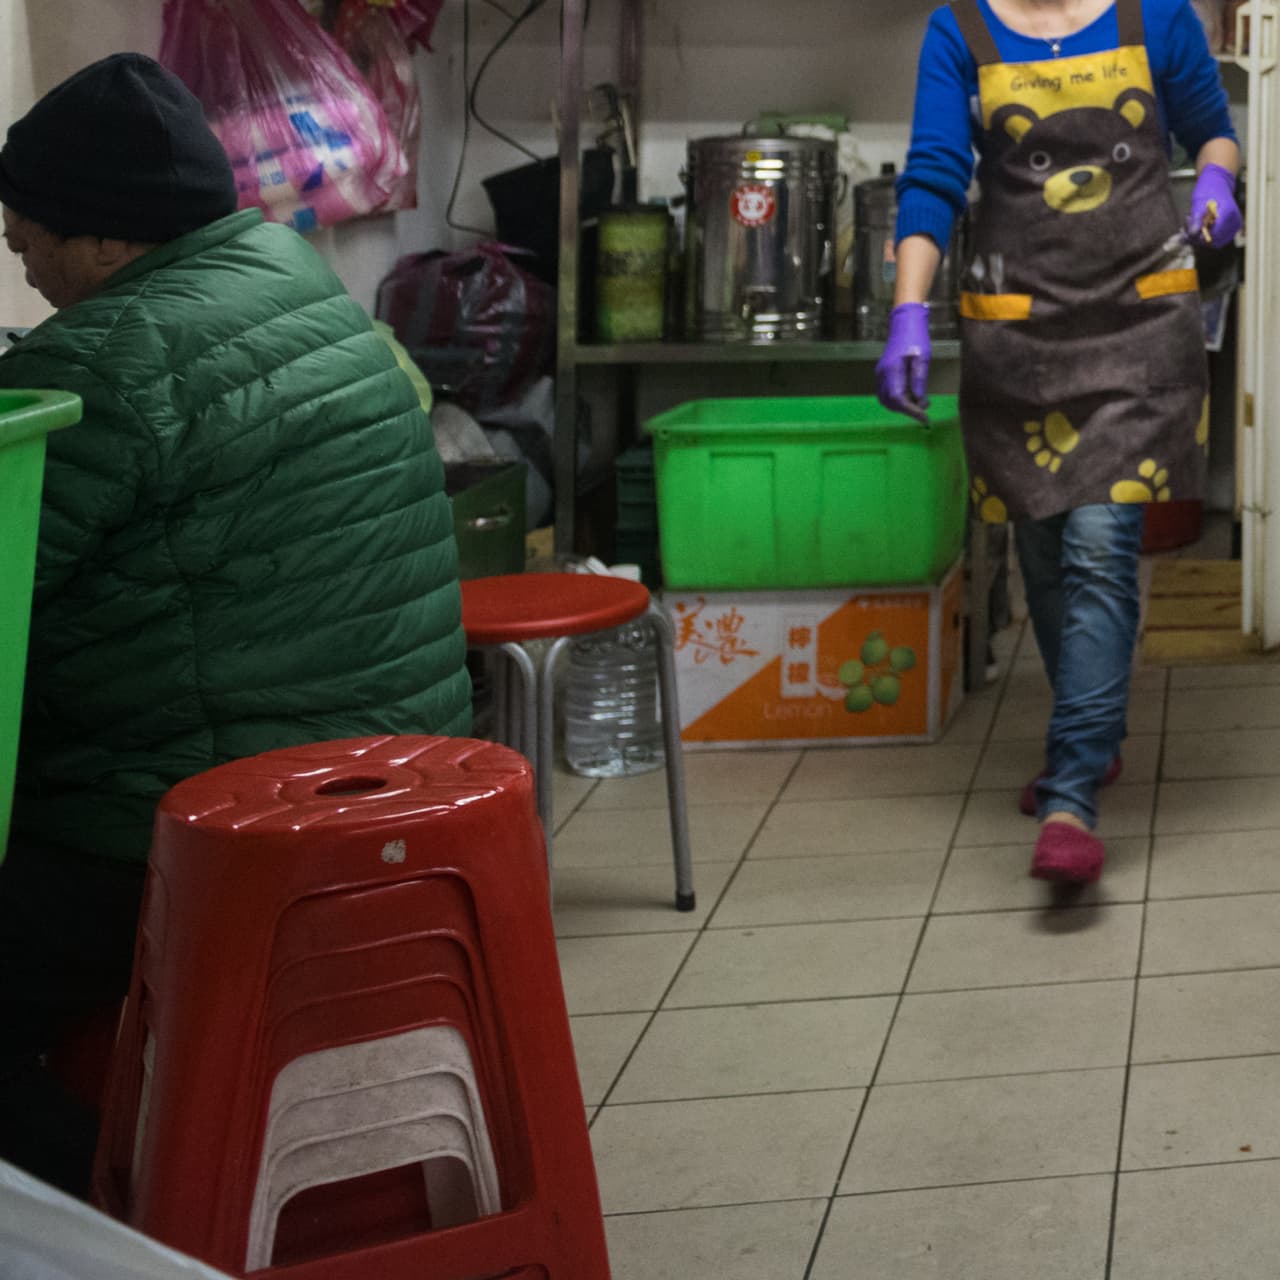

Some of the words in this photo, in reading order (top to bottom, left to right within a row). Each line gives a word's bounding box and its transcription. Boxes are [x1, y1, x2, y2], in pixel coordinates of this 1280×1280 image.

[1010, 75, 1062, 93] Giving
[1070, 72, 1094, 84] me
[1103, 58, 1128, 79] life
[763, 703, 833, 720] Lemon
